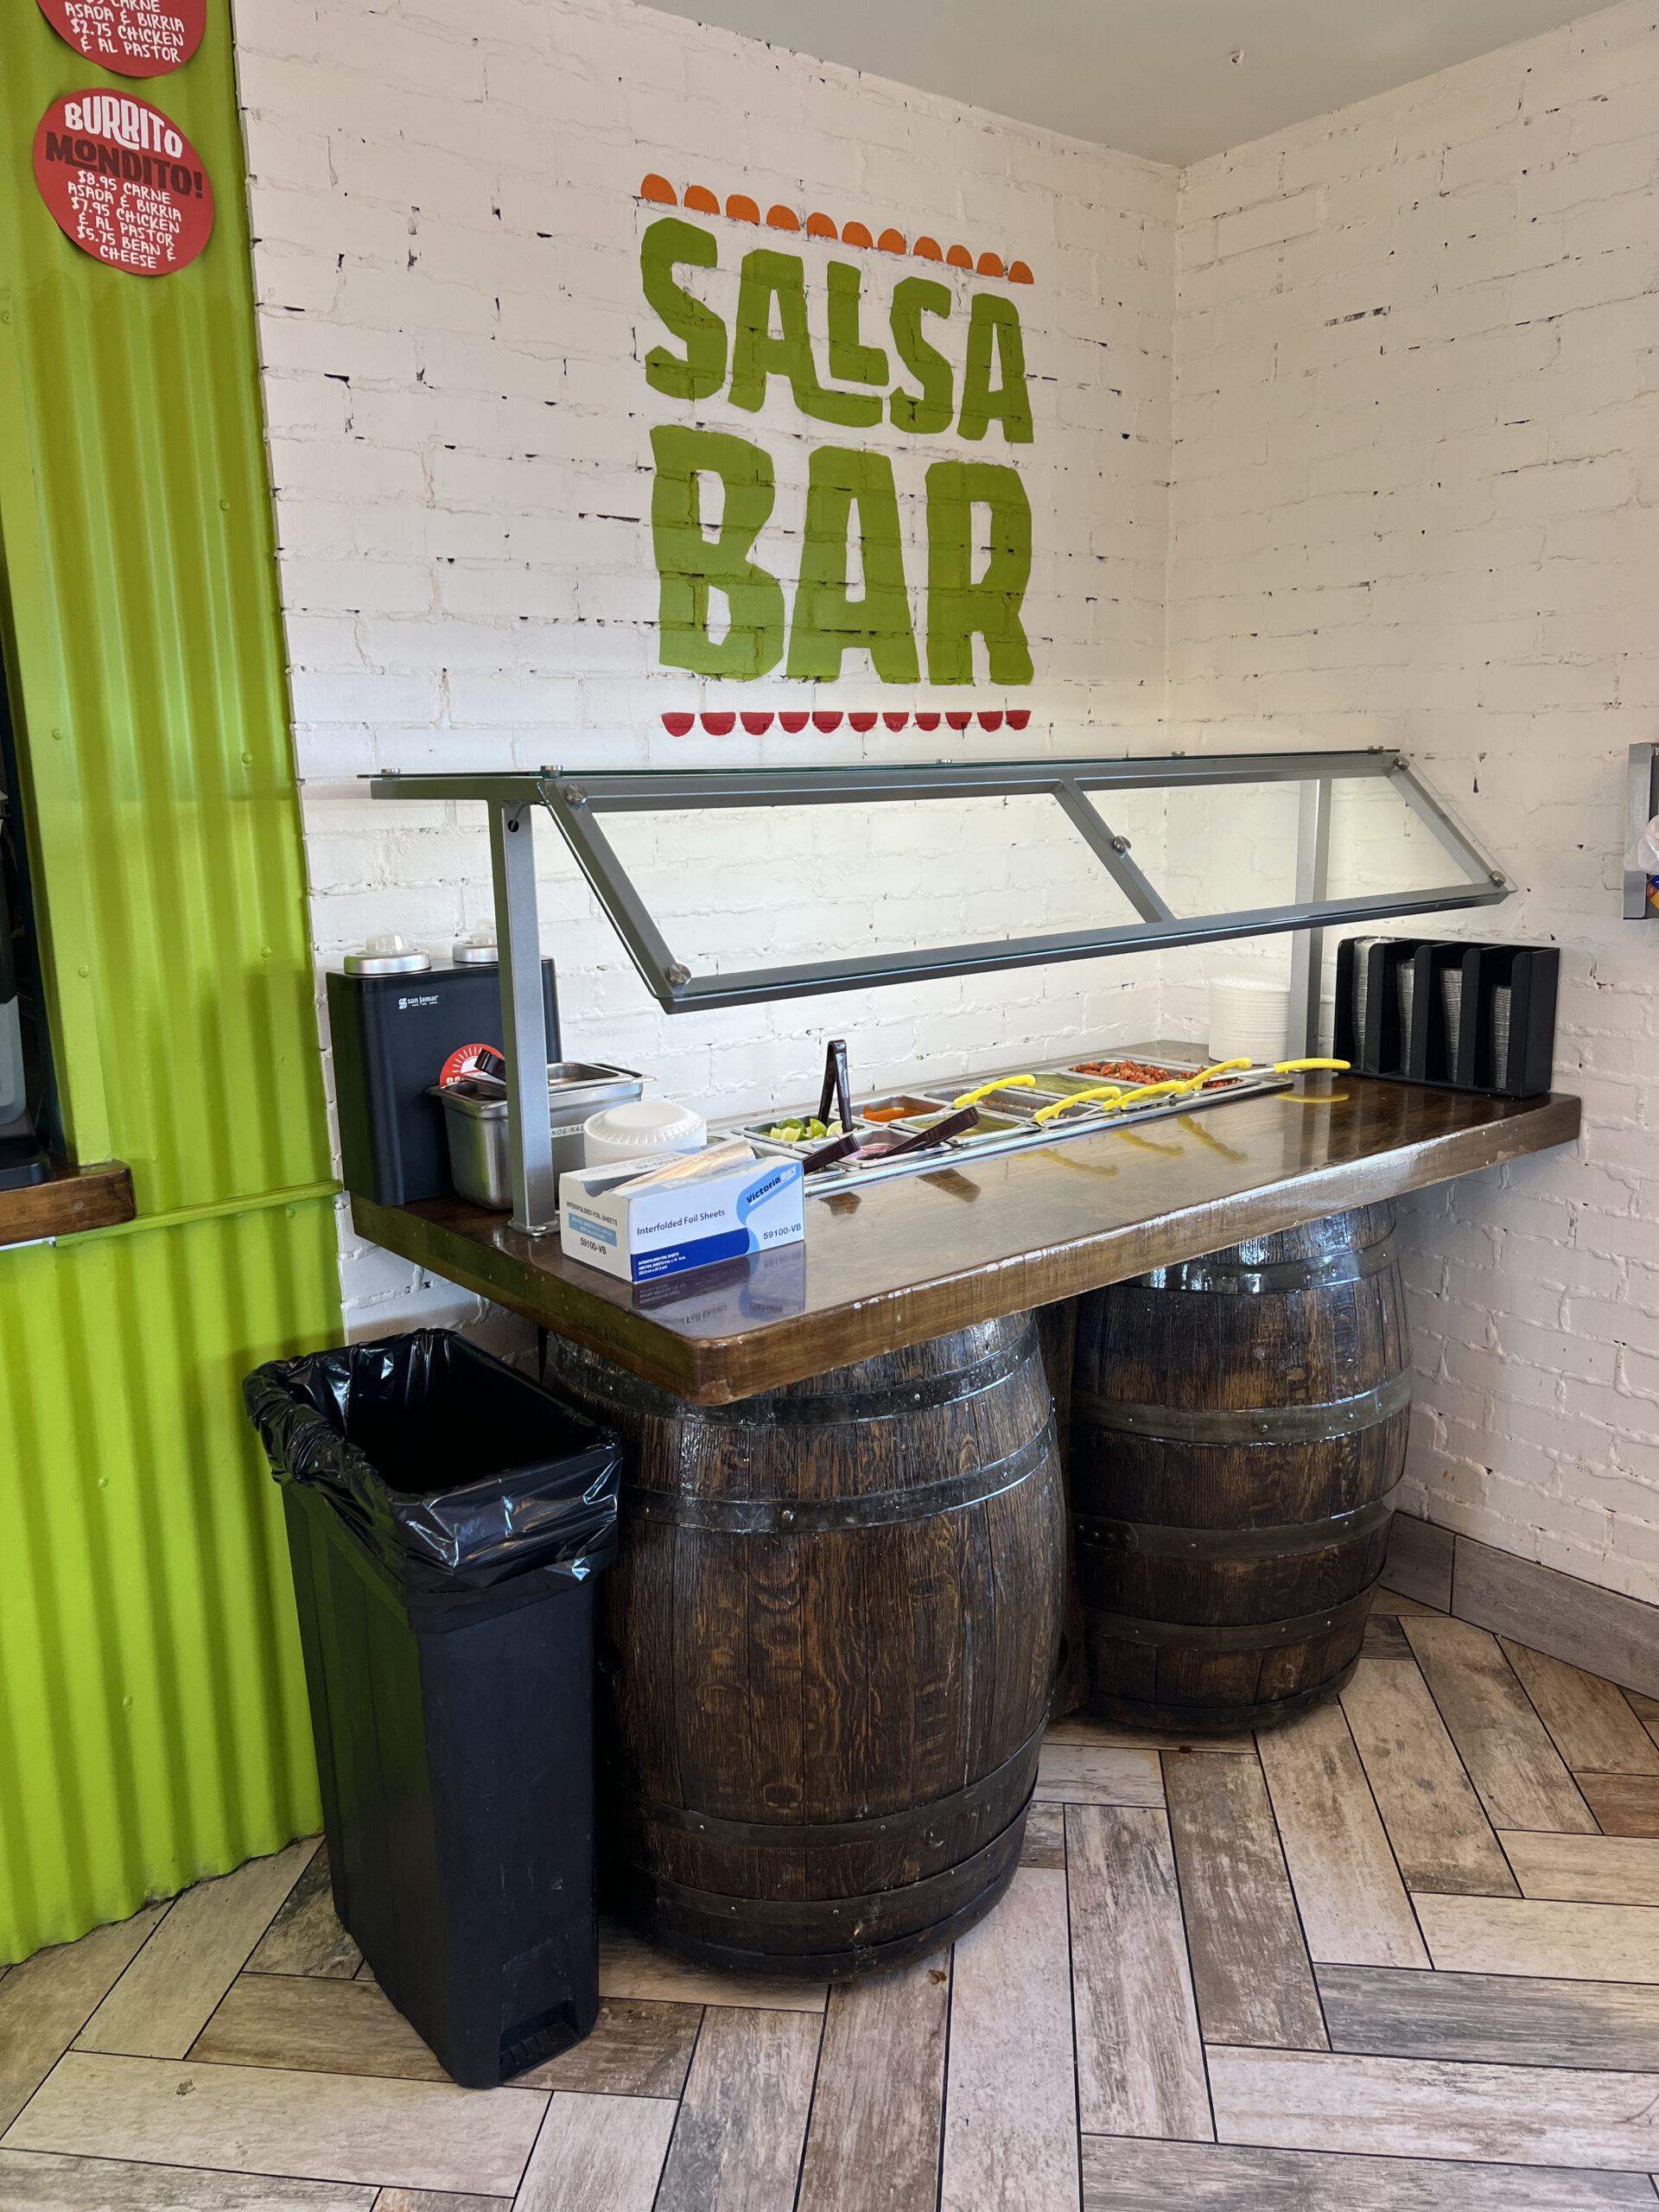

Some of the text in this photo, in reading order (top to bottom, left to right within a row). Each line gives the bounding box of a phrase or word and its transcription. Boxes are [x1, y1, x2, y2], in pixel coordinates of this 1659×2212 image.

[65, 2, 185, 33] ASADA & BIRRIA
[70, 17, 184, 47] $2.75 CHICKEN
[80, 35, 181, 63] & AL PASTOR
[64, 95, 183, 159] BURRITO
[45, 131, 203, 199] MONDITO!
[67, 181, 181, 222] ASADA & BIRRIA
[77, 168, 171, 205] $8.95 CARNE
[70, 195, 180, 233] $7.95 CHICKEN
[78, 211, 175, 247] & AL PASTOR
[76, 225, 177, 262] $5.75 BEAN &
[99, 244, 157, 269] CHEESE
[640, 217, 1034, 443] SALSA
[650, 424, 1035, 686] BAR
[637, 1209, 725, 1236] Interfolded Foil Sheets
[763, 1223, 802, 1240] 59100-VB
[580, 1236, 607, 1255] 59100-VB
